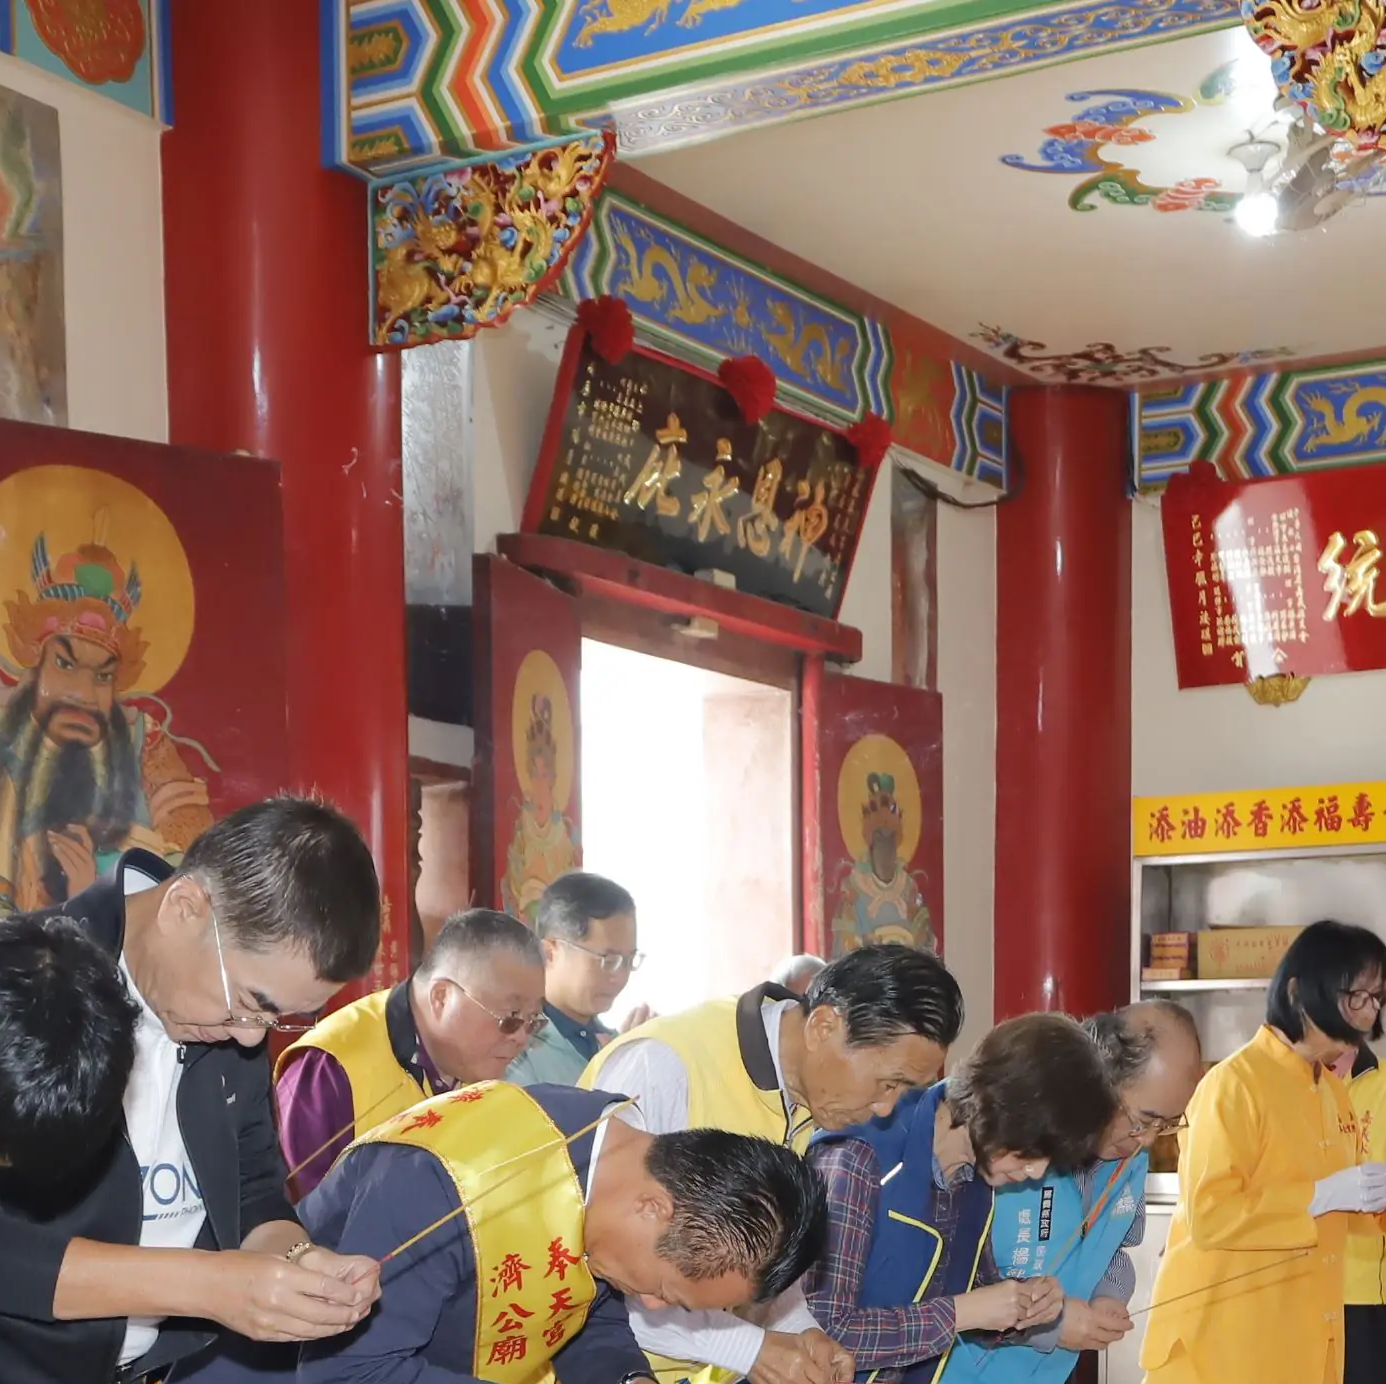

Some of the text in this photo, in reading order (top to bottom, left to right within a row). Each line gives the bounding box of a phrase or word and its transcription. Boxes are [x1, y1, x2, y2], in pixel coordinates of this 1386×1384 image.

[484, 1253, 535, 1366] 濟公廟
[541, 1236, 582, 1348] 奉天宮
